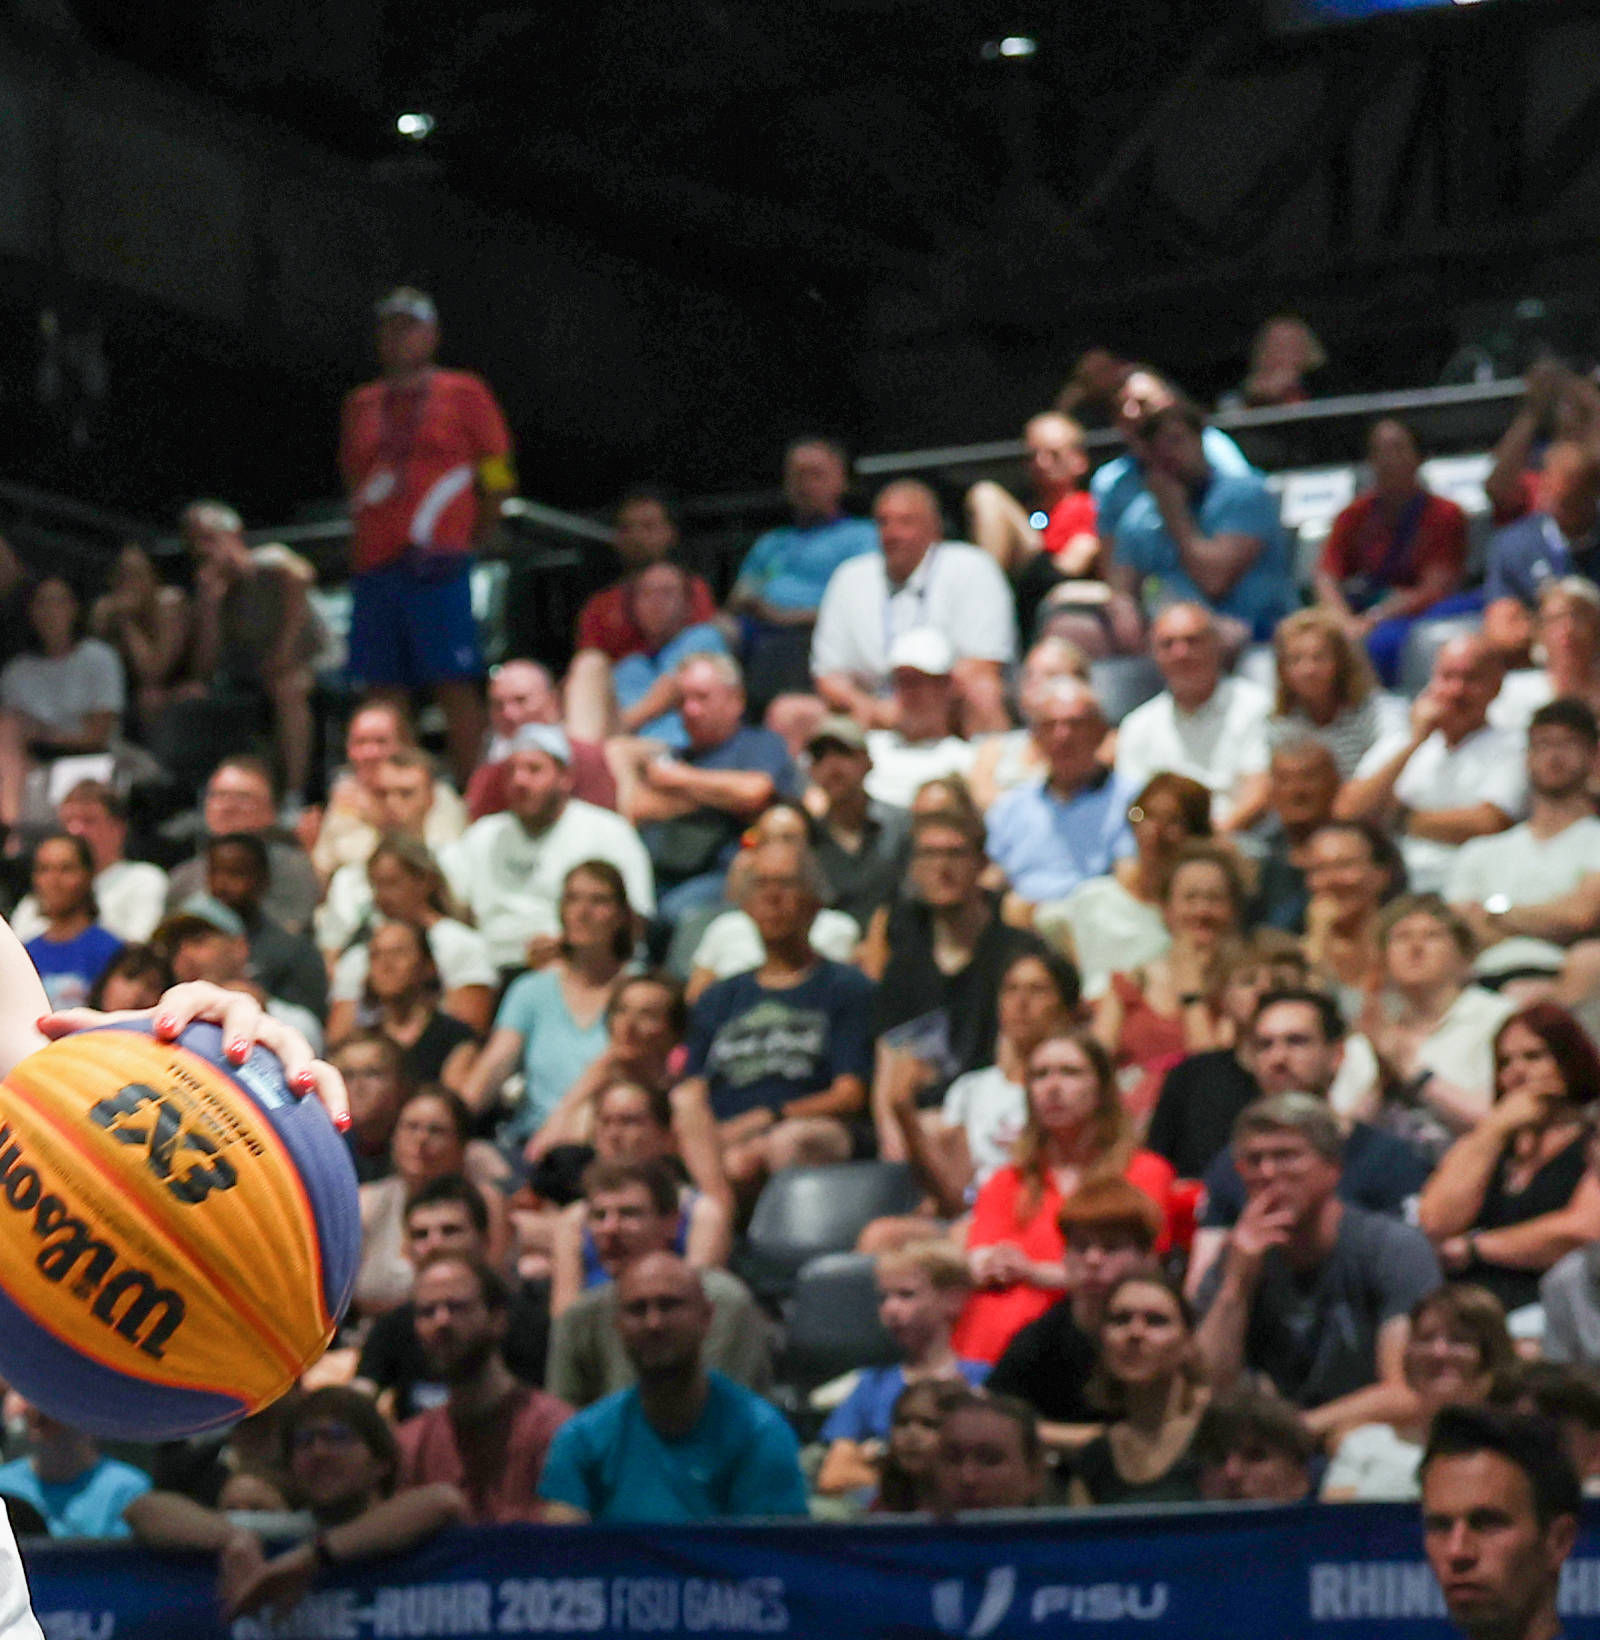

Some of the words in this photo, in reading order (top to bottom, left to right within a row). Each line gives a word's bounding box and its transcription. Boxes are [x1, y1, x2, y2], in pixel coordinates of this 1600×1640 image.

[497, 1577, 606, 1633] 2025
[610, 1577, 679, 1632] FISU
[683, 1576, 789, 1633] GAMES
[1031, 1582, 1168, 1623] FISU
